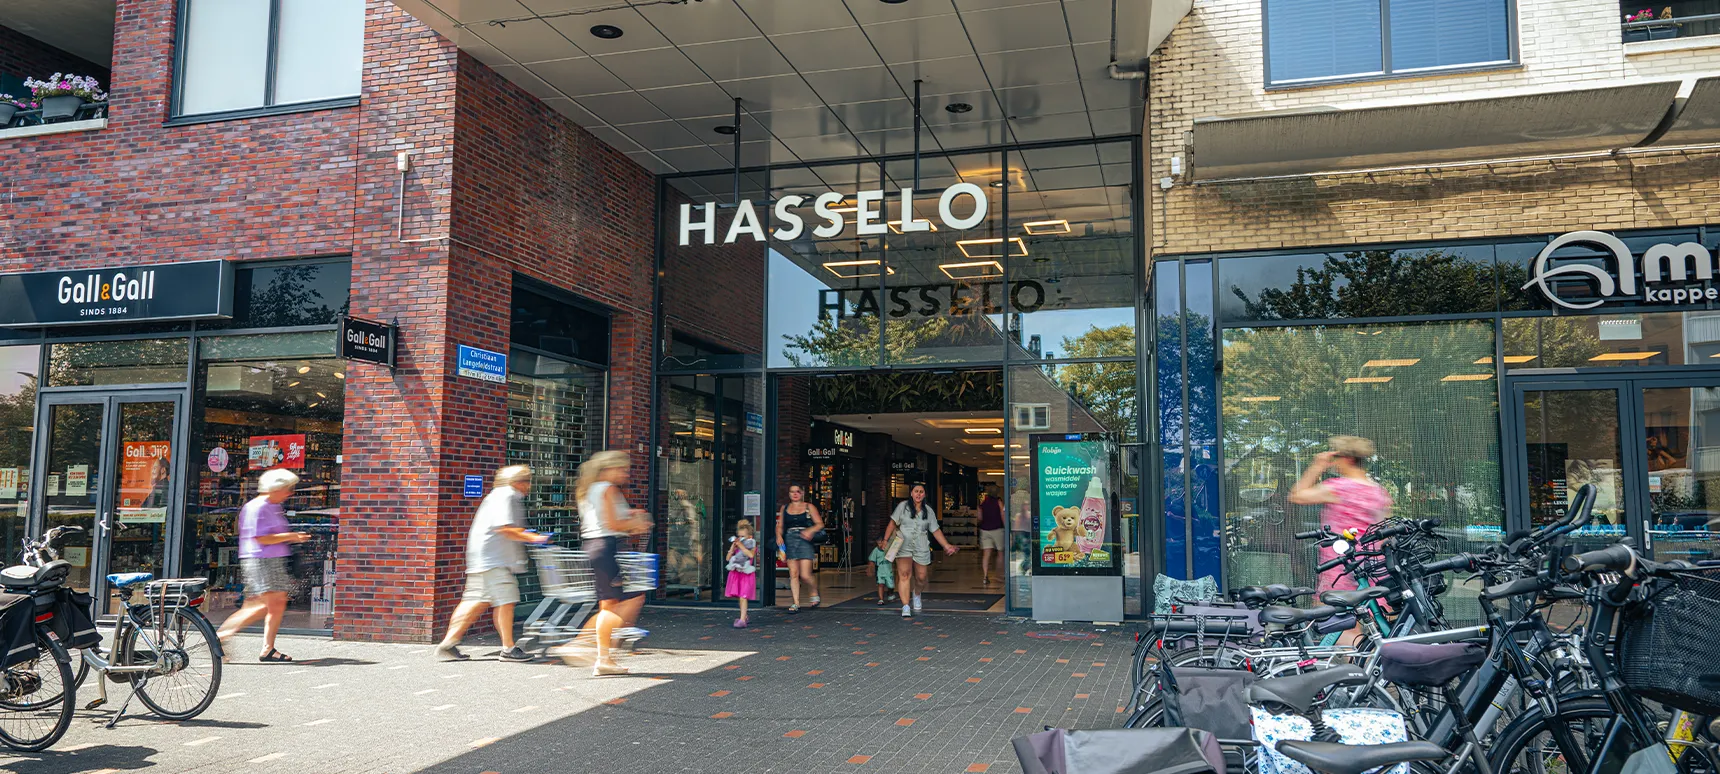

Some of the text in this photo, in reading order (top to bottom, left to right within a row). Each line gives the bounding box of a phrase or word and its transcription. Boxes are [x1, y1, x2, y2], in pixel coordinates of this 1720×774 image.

[679, 182, 989, 247] HASSELO
[57, 270, 155, 305] Gall&Gall
[109, 307, 128, 315] 1884
[347, 328, 386, 349] Gall&Gall
[470, 350, 497, 362] Christiaan
[1044, 465, 1097, 475] Quickwash
